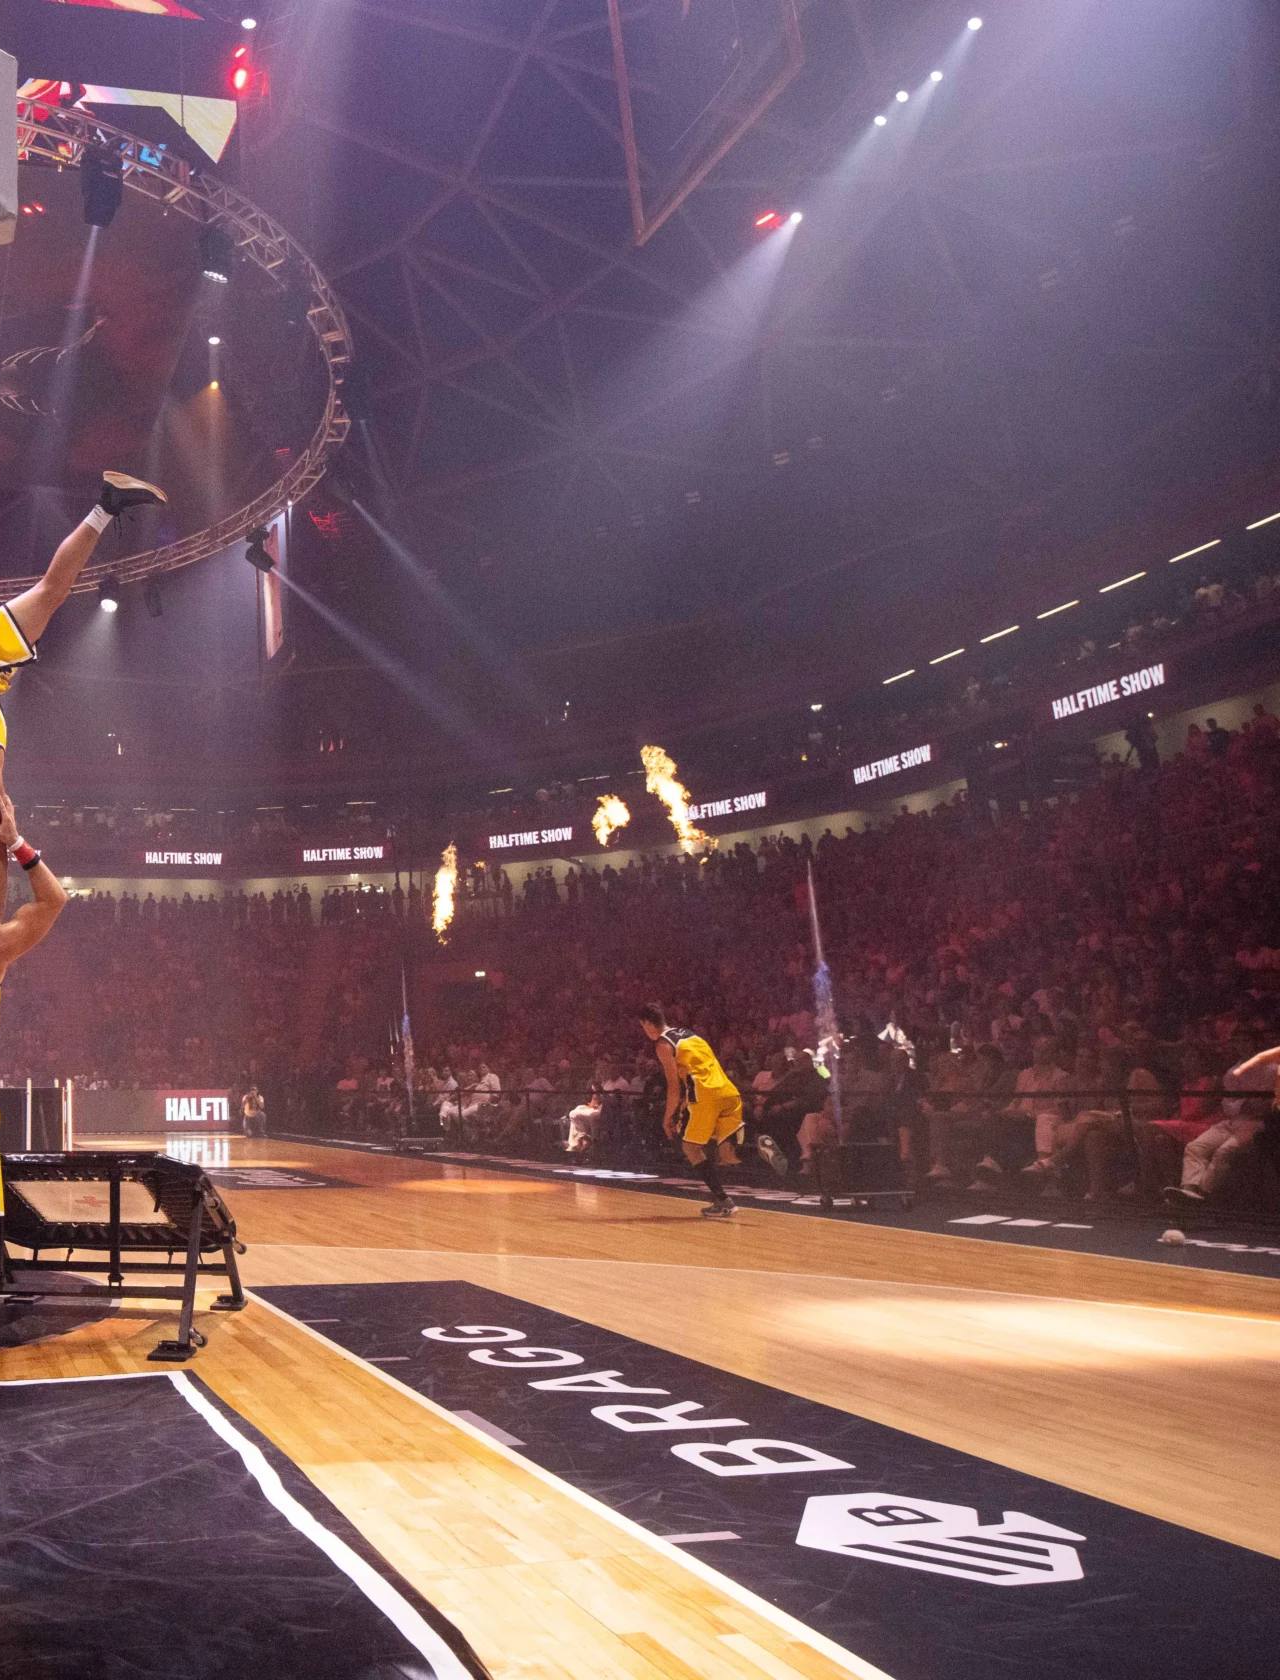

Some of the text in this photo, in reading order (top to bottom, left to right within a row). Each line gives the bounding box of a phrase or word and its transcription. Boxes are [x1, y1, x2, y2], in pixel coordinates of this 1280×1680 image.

[1052, 663, 1165, 720] HALFTIME SHOW
[853, 744, 931, 785] HALFTIME SHOW
[684, 791, 766, 820] ALFTIME SHOW
[489, 827, 573, 849] HALFTIME SHOW
[145, 851, 222, 865] HALFTIME SHOW
[303, 846, 384, 862] HALFTIME SHOW
[165, 1097, 228, 1121] HALFTI
[421, 1325, 856, 1477] BRAGG
